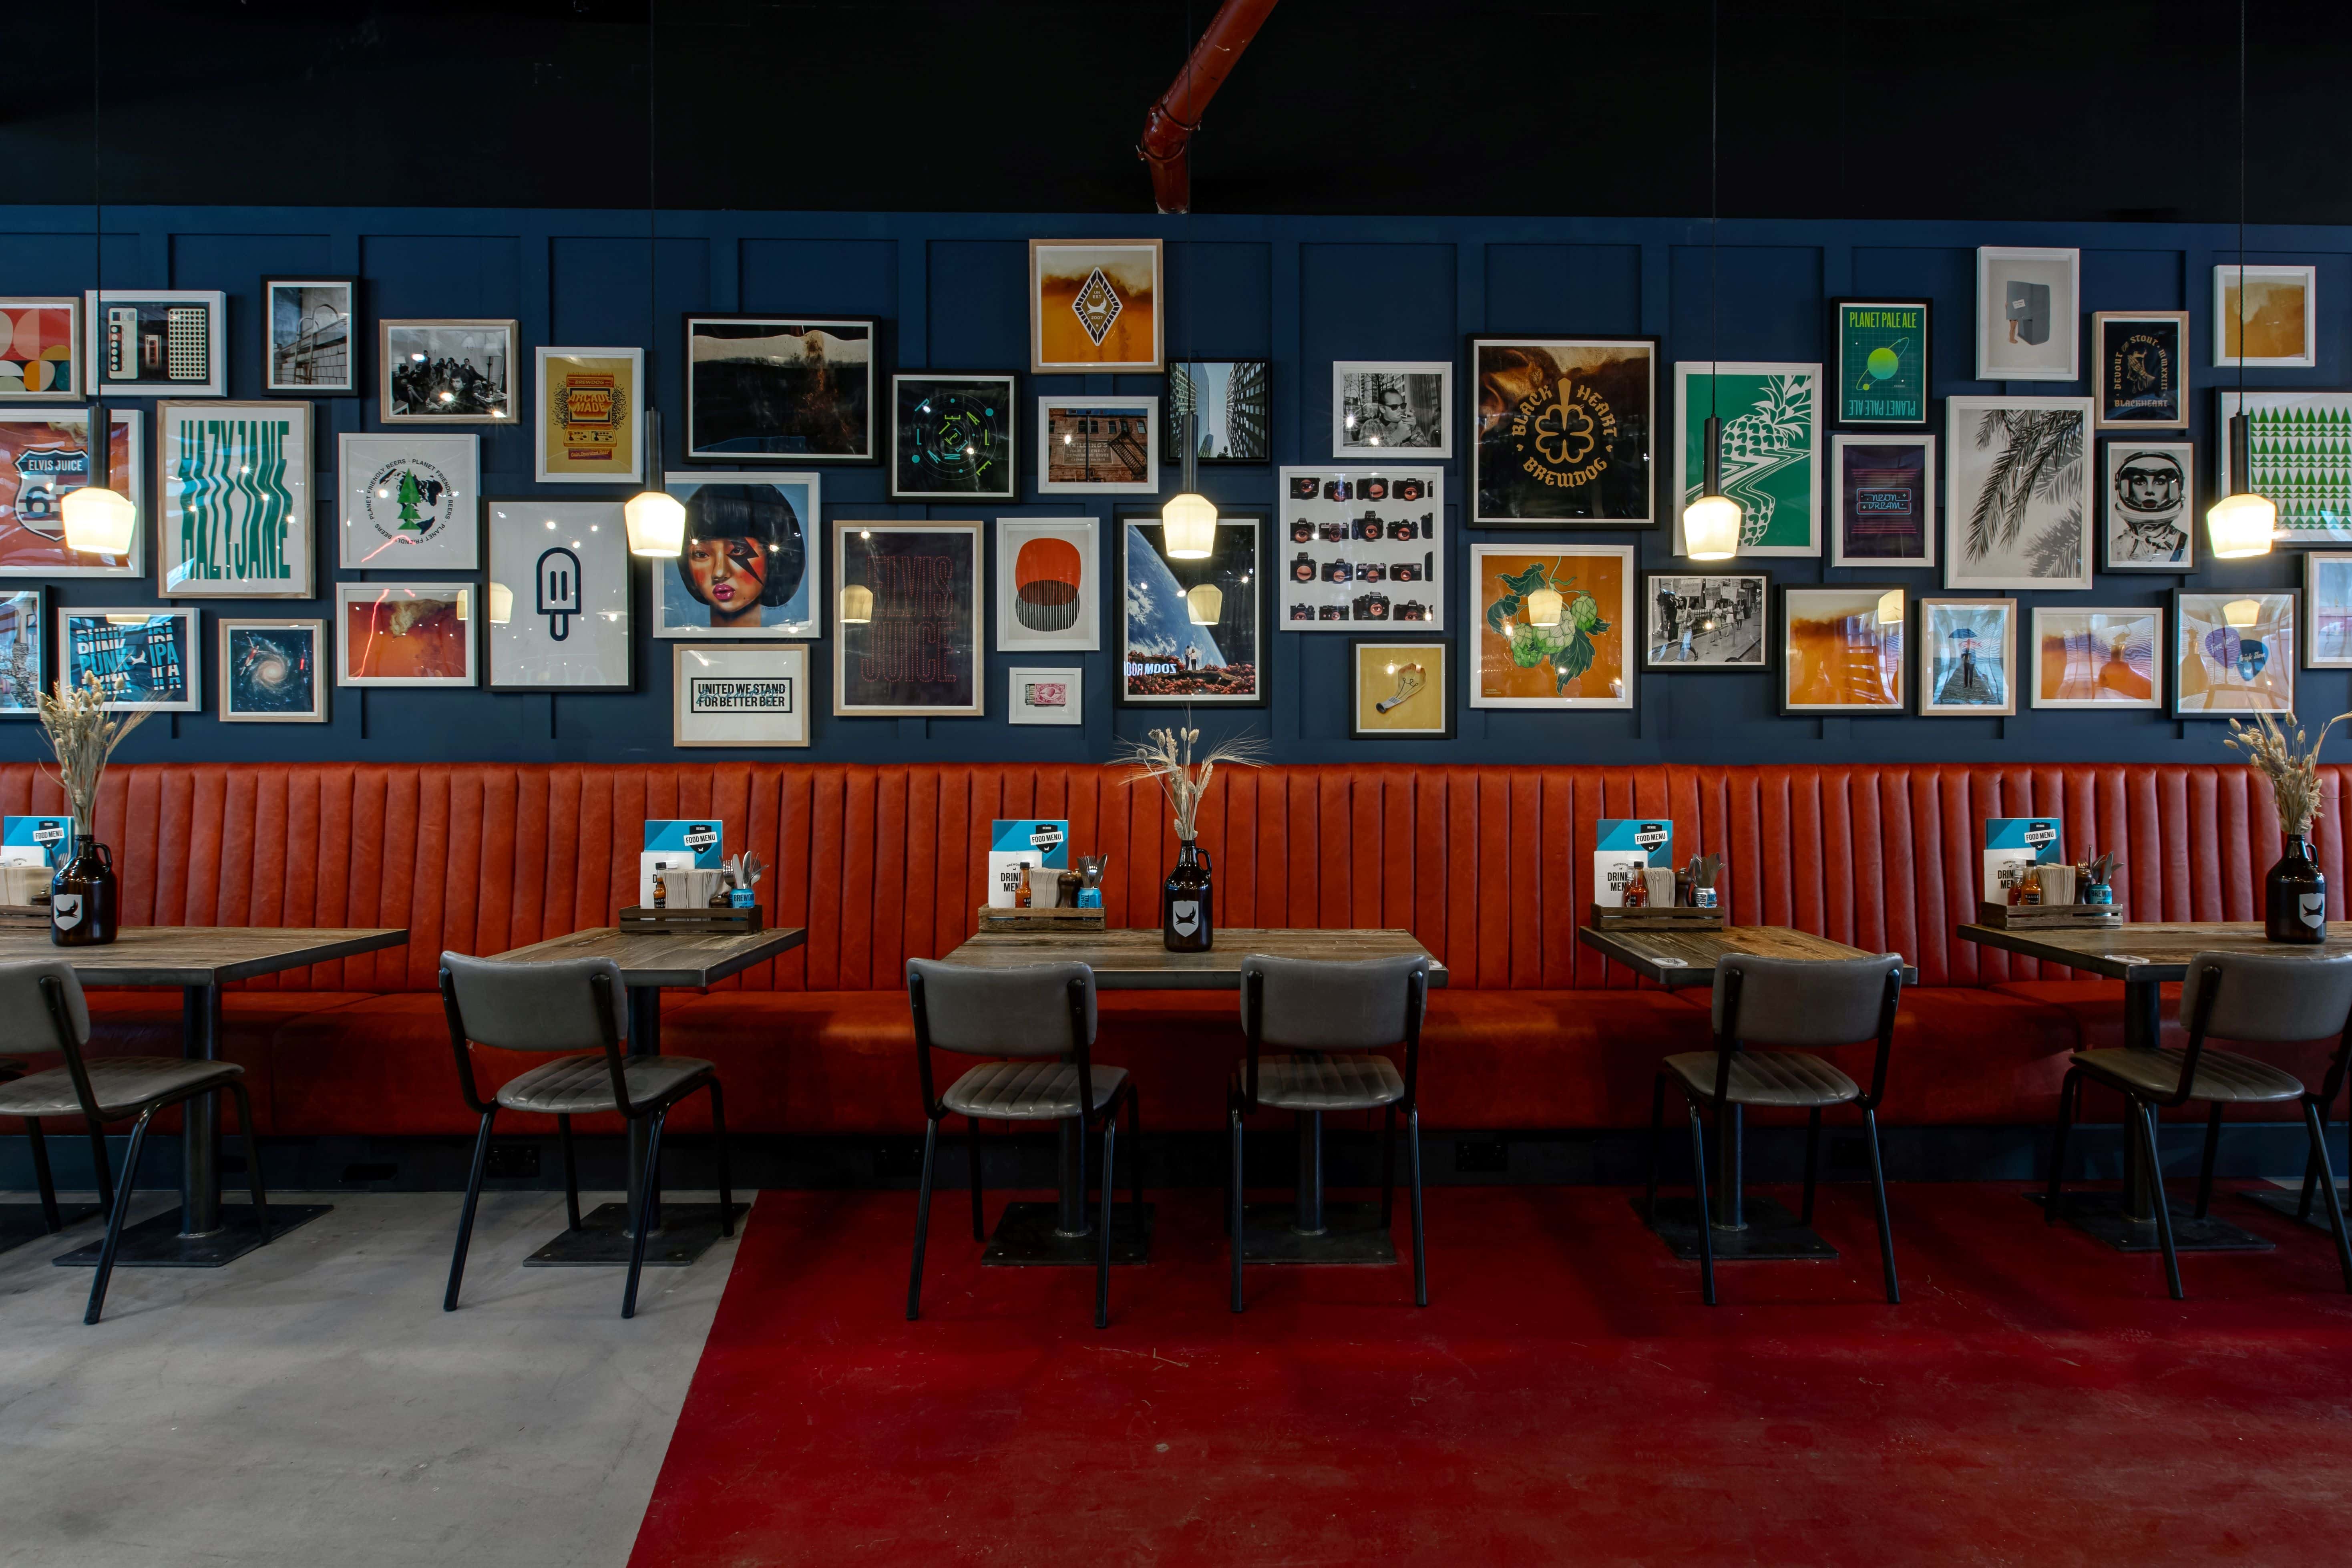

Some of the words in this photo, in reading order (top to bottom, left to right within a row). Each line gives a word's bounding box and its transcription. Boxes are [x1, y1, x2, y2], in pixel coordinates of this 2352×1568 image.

[1849, 312, 1880, 327] PLANET
[1882, 312, 1901, 328] PALE
[1902, 313, 1917, 328] ALE
[2130, 335, 2159, 346] STOUT
[569, 394, 611, 402] ARCADE
[573, 402, 608, 412] MADE
[1512, 385, 1552, 436] BLACK
[1576, 385, 1617, 437] HEART
[1849, 400, 1863, 416] ALE
[1865, 400, 1884, 416] PALE
[1886, 401, 1916, 416] PLANET
[28, 460, 54, 471] ELVIS
[55, 460, 83, 471] JUICE
[386, 459, 406, 469] BEERS
[1523, 456, 1607, 487] BREWDOG
[368, 468, 385, 494] FRIENDLY
[412, 459, 436, 471] PLANET
[435, 470, 453, 497] FRIENDLY
[445, 499, 453, 520] BEERS
[366, 496, 375, 520] PLANET
[375, 523, 392, 539] BEERS
[426, 523, 445, 541] PLANET
[868, 556, 953, 617] ELVIS
[149, 641, 179, 667] IPA
[861, 621, 957, 682] JUICE
[698, 683, 734, 694] UNITED
[736, 683, 751, 694] WE
[753, 683, 786, 694] STAND
[699, 696, 718, 707] FOR
[720, 696, 758, 707] BETTER
[759, 696, 785, 707] BEER
[48, 830, 63, 838] MENU
[700, 834, 716, 842] MENU
[1046, 833, 1061, 841] MENU
[1998, 870, 2015, 879] DRIN
[1610, 882, 1626, 891] MEN
